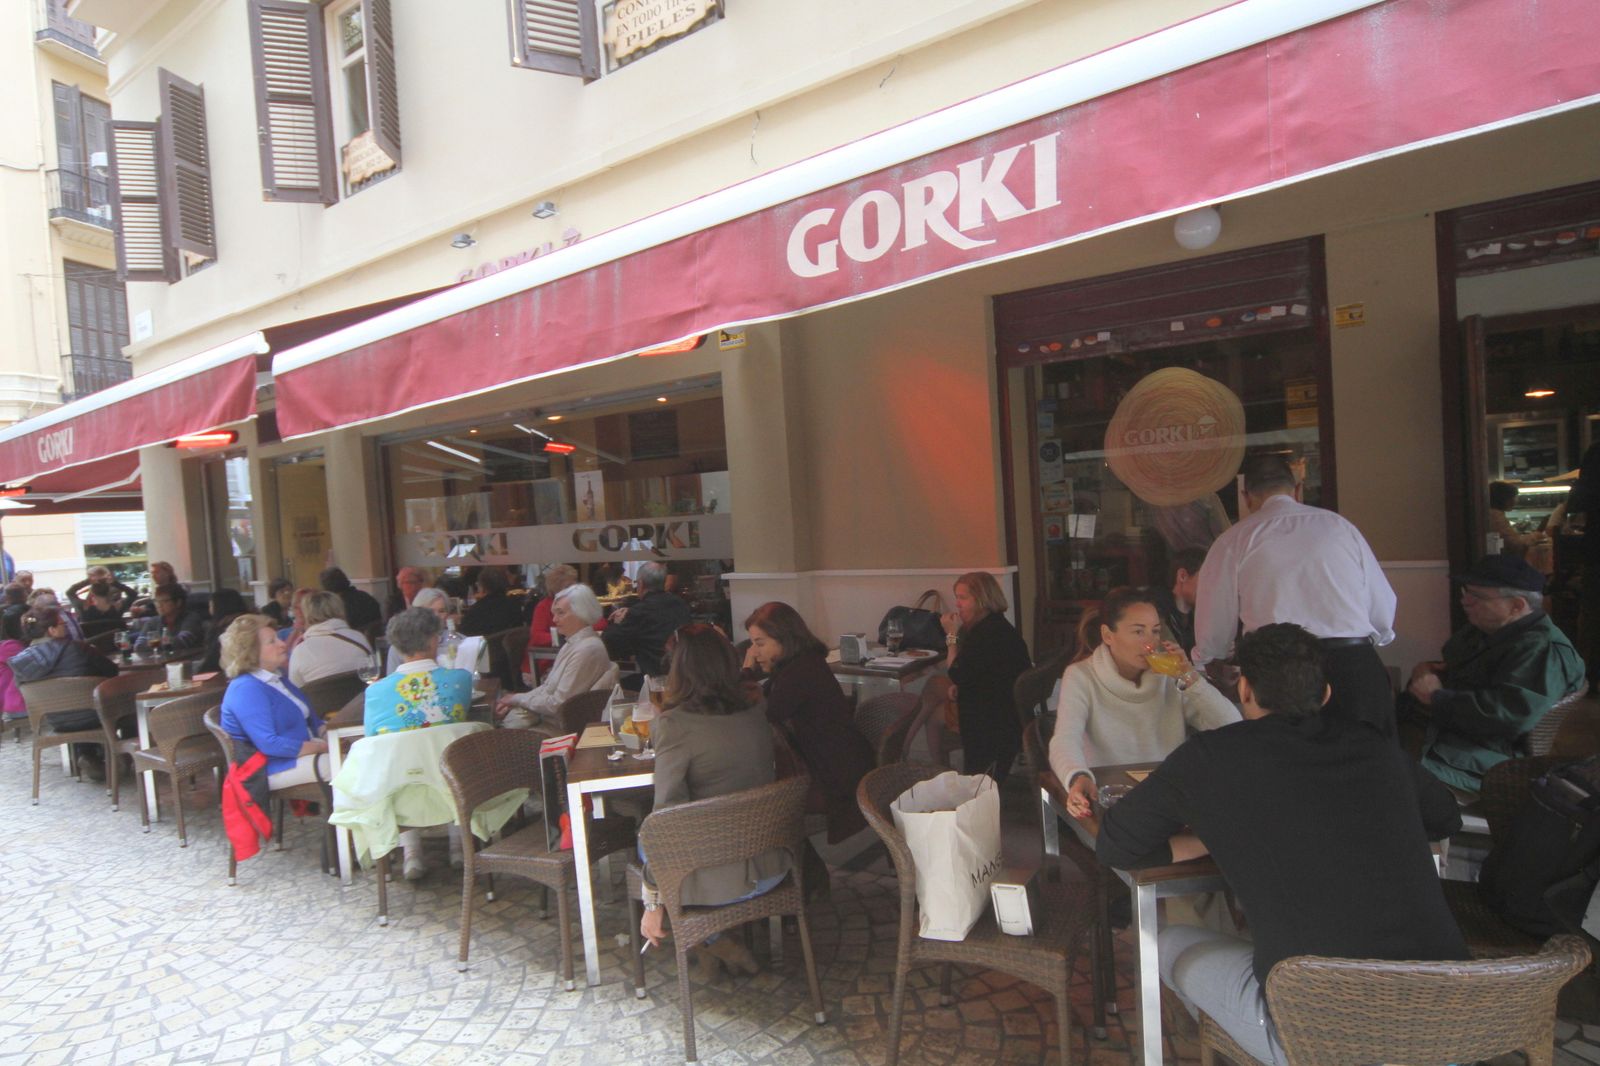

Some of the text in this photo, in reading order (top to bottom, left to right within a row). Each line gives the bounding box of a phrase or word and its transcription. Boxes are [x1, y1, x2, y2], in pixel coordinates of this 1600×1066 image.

[625, 3, 697, 47] PIELES
[632, 4, 662, 28] TODO
[787, 131, 1062, 278] GORKI
[37, 426, 73, 464] GORKI
[1124, 424, 1194, 446] GORKI
[572, 520, 700, 558] GORKI
